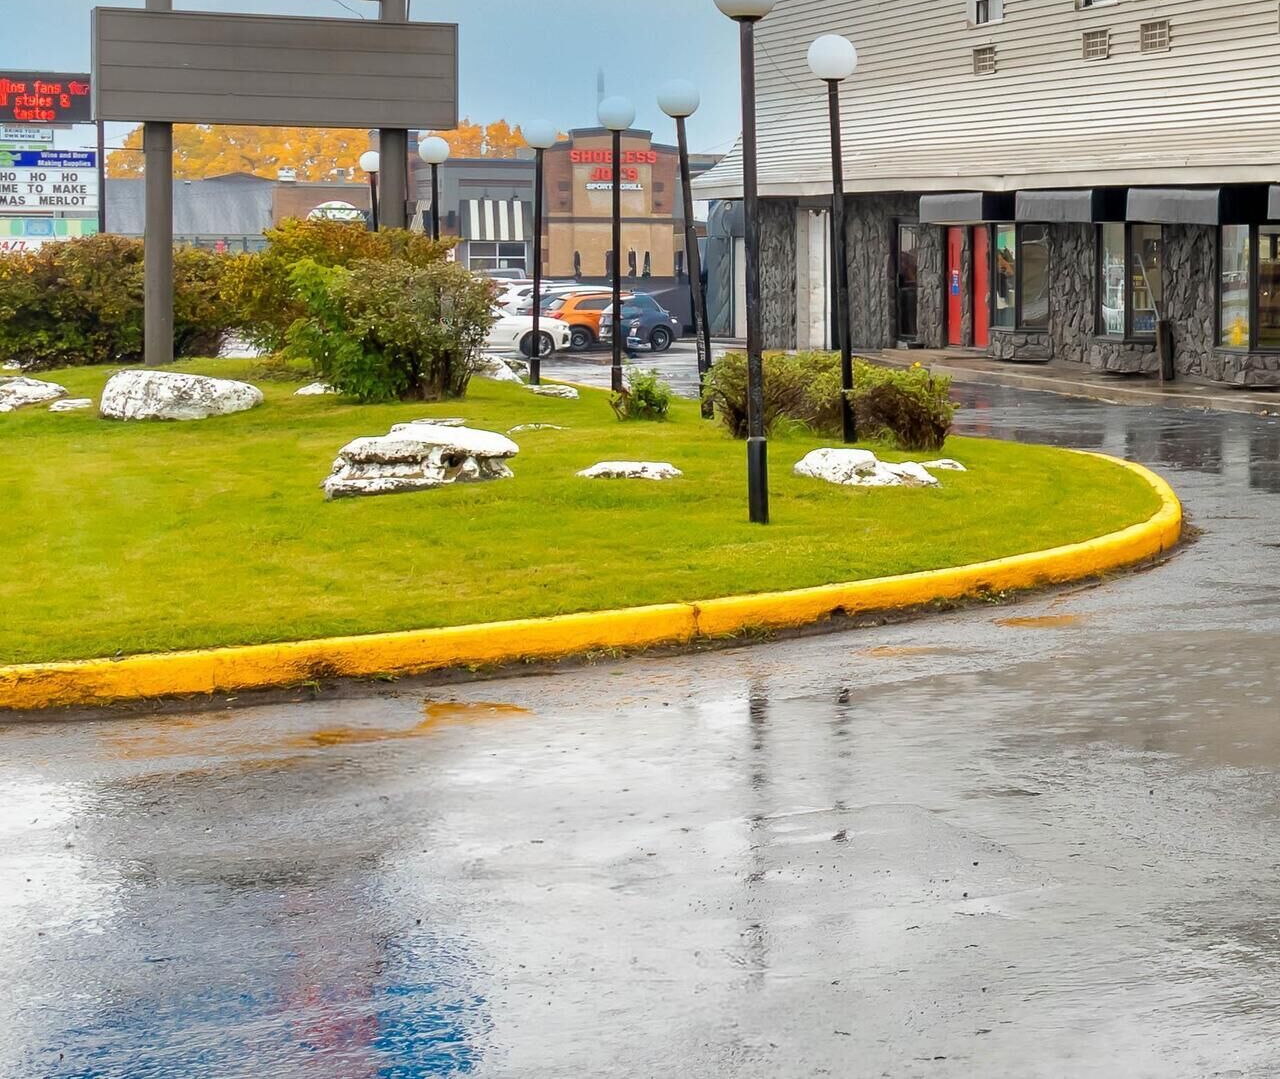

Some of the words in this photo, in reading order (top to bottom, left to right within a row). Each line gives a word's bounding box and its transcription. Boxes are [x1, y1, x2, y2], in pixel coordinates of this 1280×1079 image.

[0, 172, 17, 181] HO
[30, 172, 47, 182] HO
[62, 173, 79, 182] HO
[27, 184, 44, 193] TO
[52, 184, 87, 194] MAKE
[39, 196, 87, 206] MERLOT
